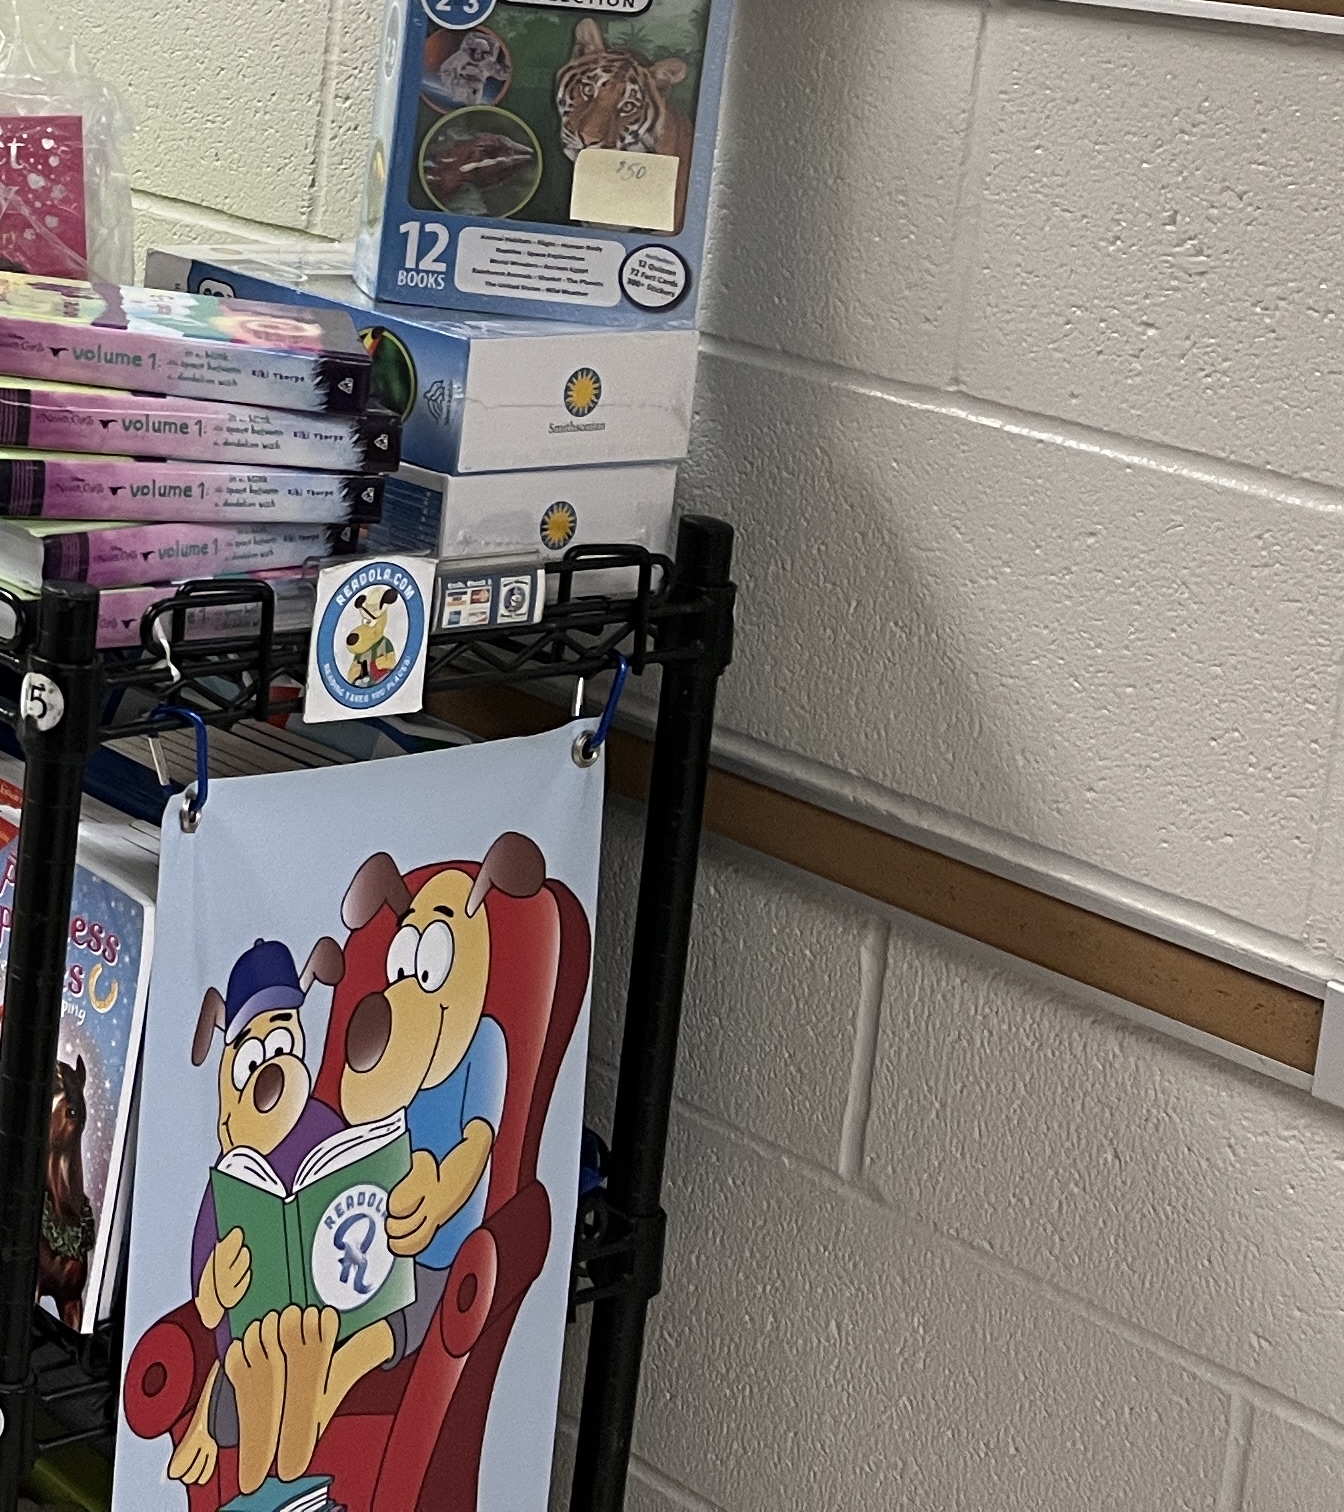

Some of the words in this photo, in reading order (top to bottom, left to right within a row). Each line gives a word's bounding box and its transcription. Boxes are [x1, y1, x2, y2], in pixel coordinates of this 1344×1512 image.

[398, 221, 450, 272] 12
[397, 269, 445, 289] BOOKS
[72, 344, 143, 368] volume
[122, 414, 189, 436] volume
[129, 478, 193, 498] volume
[158, 539, 209, 561] volume
[335, 567, 416, 606] READOLA.COM
[30, 683, 48, 719] 5
